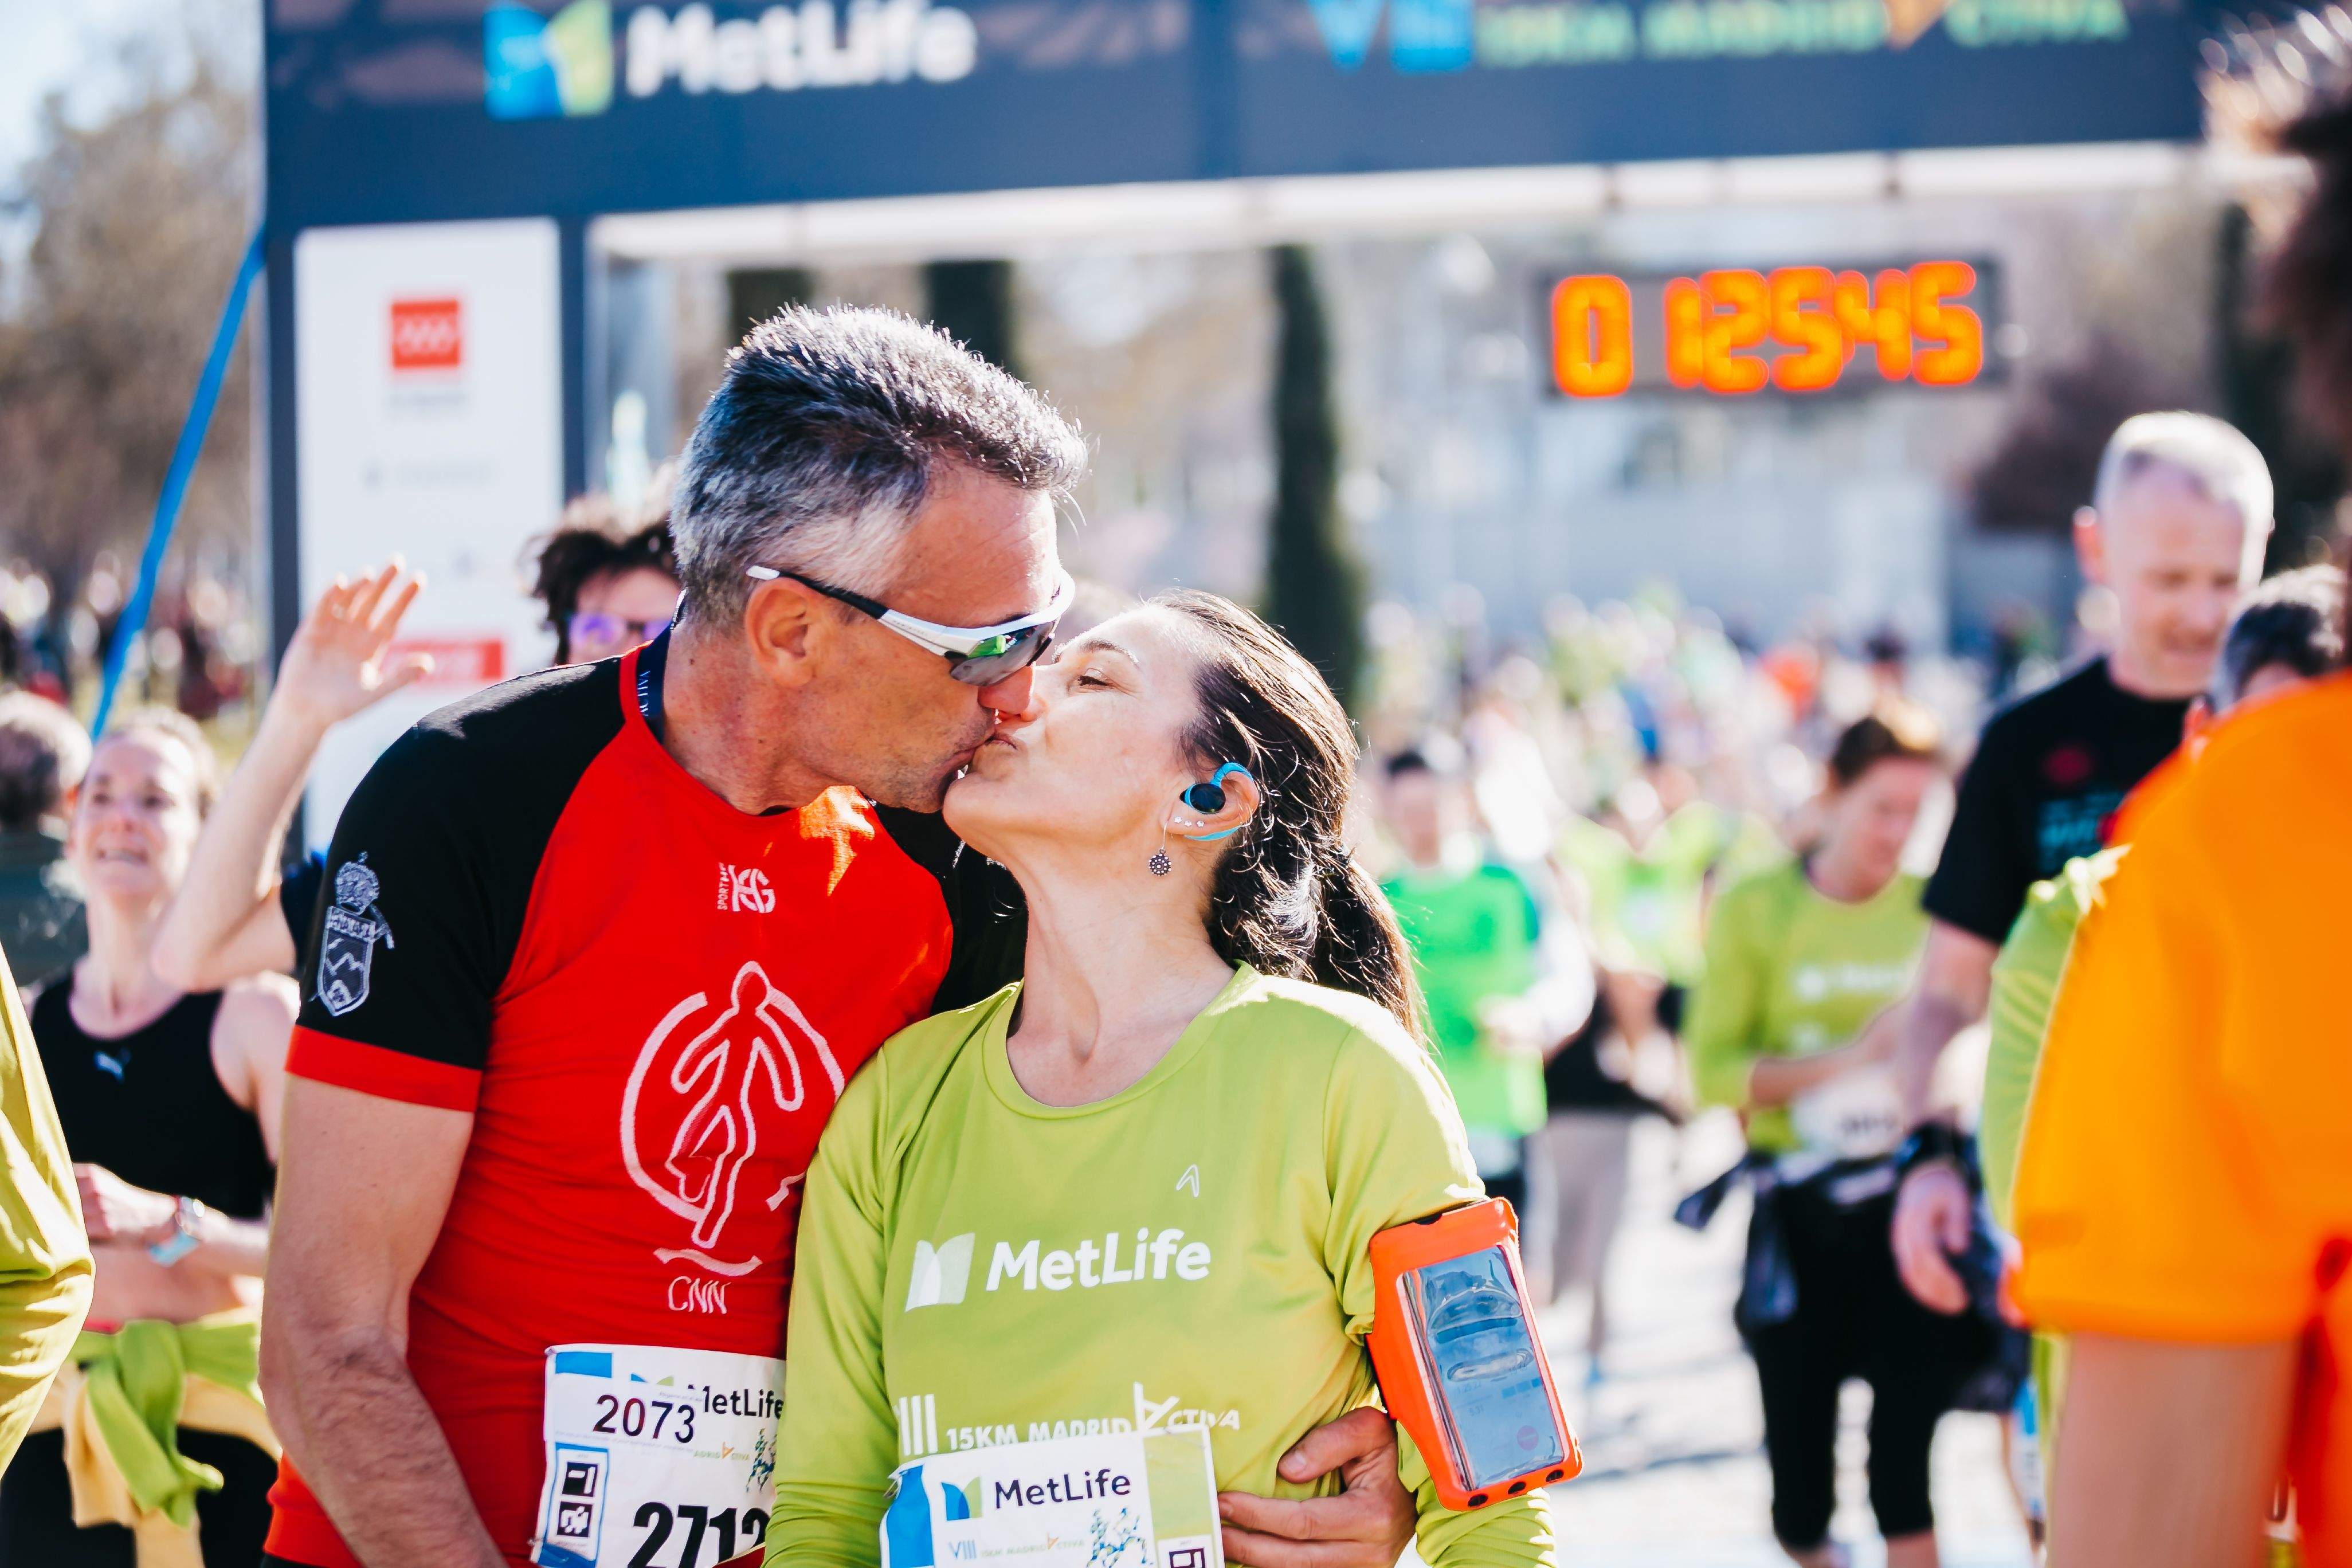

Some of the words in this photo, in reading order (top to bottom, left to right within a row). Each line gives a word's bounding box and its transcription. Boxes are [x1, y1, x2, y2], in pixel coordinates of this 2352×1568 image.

[626, 0, 978, 97] MetLife
[986, 1227, 1210, 1291] MetLife
[668, 1276, 731, 1314] CNN
[593, 1394, 695, 1444] 2073
[946, 1424, 1019, 1451] 15KM
[1028, 1417, 1132, 1442] MADRID
[994, 1468, 1131, 1509] MetLife
[627, 1502, 771, 1568] 2712
[947, 1538, 977, 1560] VIII
